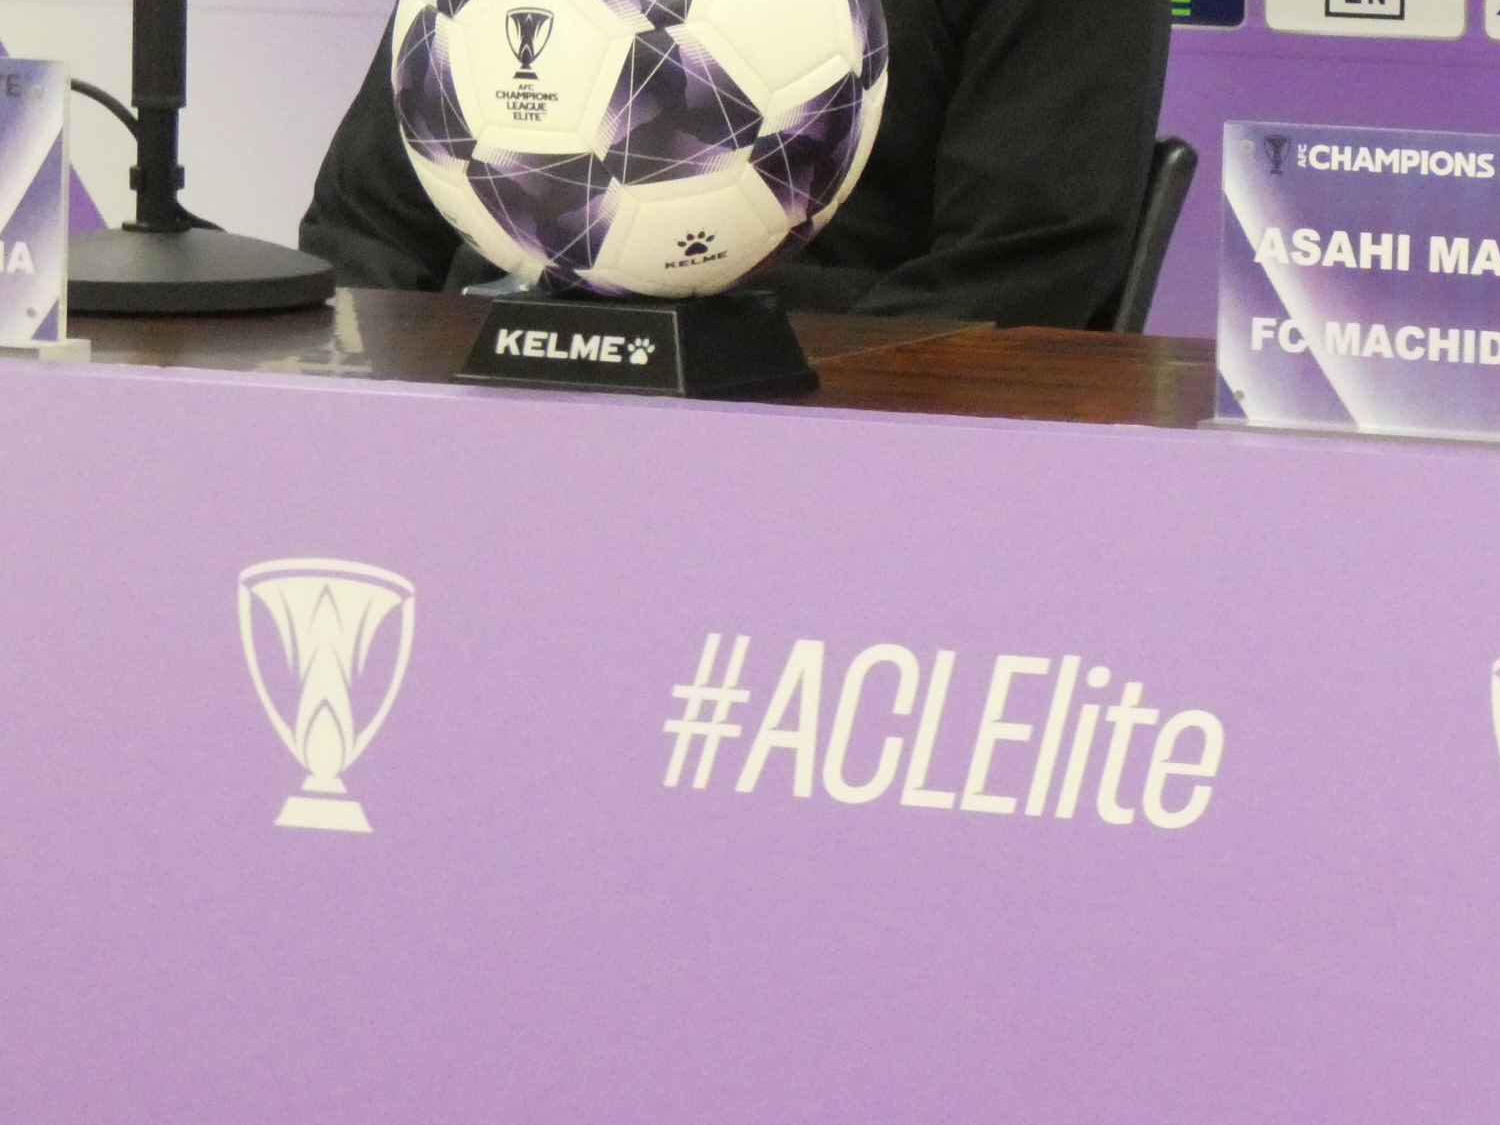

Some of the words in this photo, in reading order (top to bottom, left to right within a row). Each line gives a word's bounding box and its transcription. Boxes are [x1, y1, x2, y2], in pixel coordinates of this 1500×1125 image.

[495, 90, 559, 102] CHAMPIONS
[506, 101, 547, 112] LEAGUE
[513, 111, 542, 122] ELITE
[1297, 143, 1307, 169] AFC
[1308, 144, 1496, 178] CHAMPIONS
[664, 250, 728, 269] KELME
[1254, 227, 1411, 271] ASAHI
[494, 328, 626, 363] KELME
[1252, 317, 1308, 353] FC
[662, 632, 1225, 830] #ACLElite
